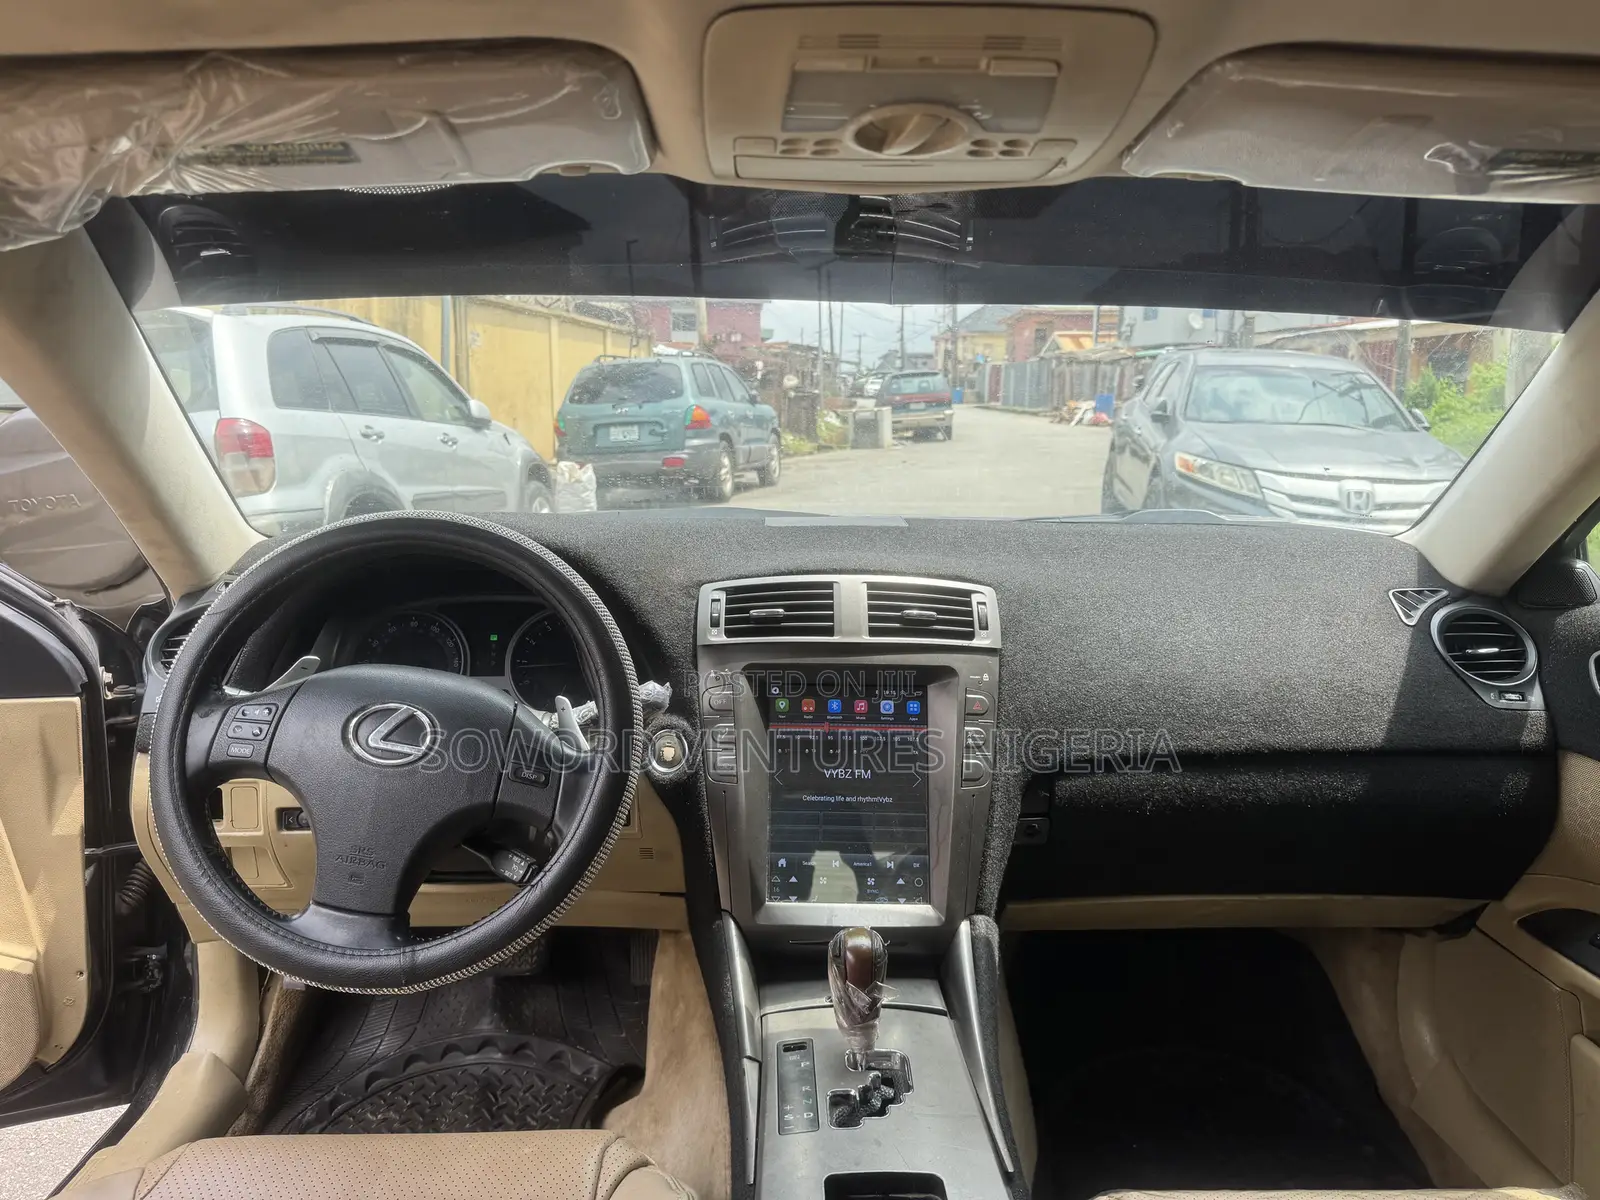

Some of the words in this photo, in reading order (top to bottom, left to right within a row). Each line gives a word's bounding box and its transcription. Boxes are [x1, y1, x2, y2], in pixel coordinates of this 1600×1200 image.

[7, 493, 81, 511] TOYOTA
[230, 746, 250, 755] MODE
[521, 771, 538, 780] DISP
[823, 768, 853, 779] VYBZ
[855, 768, 872, 779] FM
[802, 794, 835, 803] Celebrating
